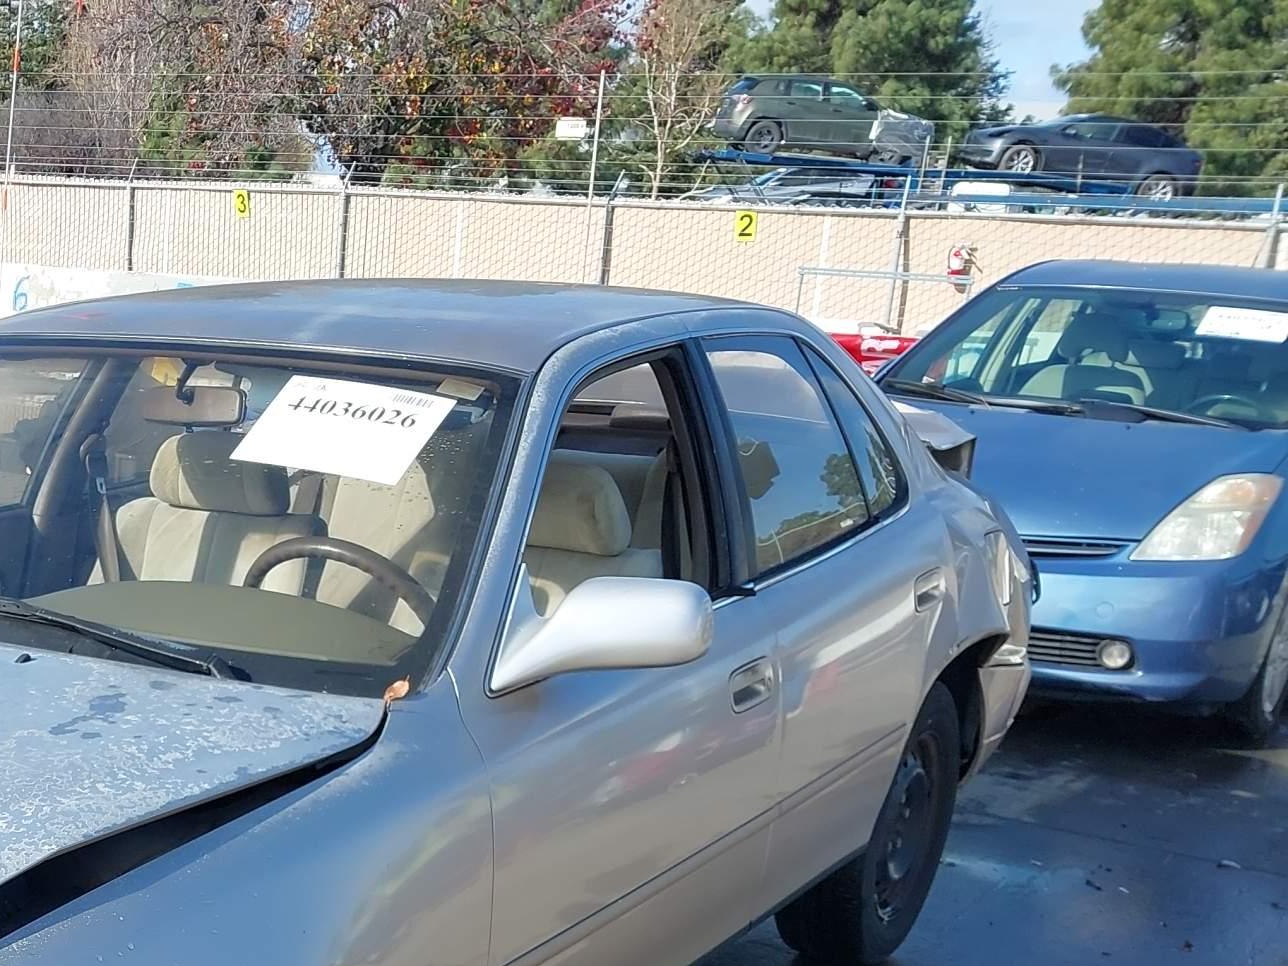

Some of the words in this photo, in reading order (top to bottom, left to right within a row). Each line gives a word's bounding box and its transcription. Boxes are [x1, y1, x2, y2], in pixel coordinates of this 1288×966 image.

[236, 193, 247, 214] 3
[738, 213, 753, 237] 2
[13, 274, 31, 311] 6
[287, 396, 420, 429] 44036026
